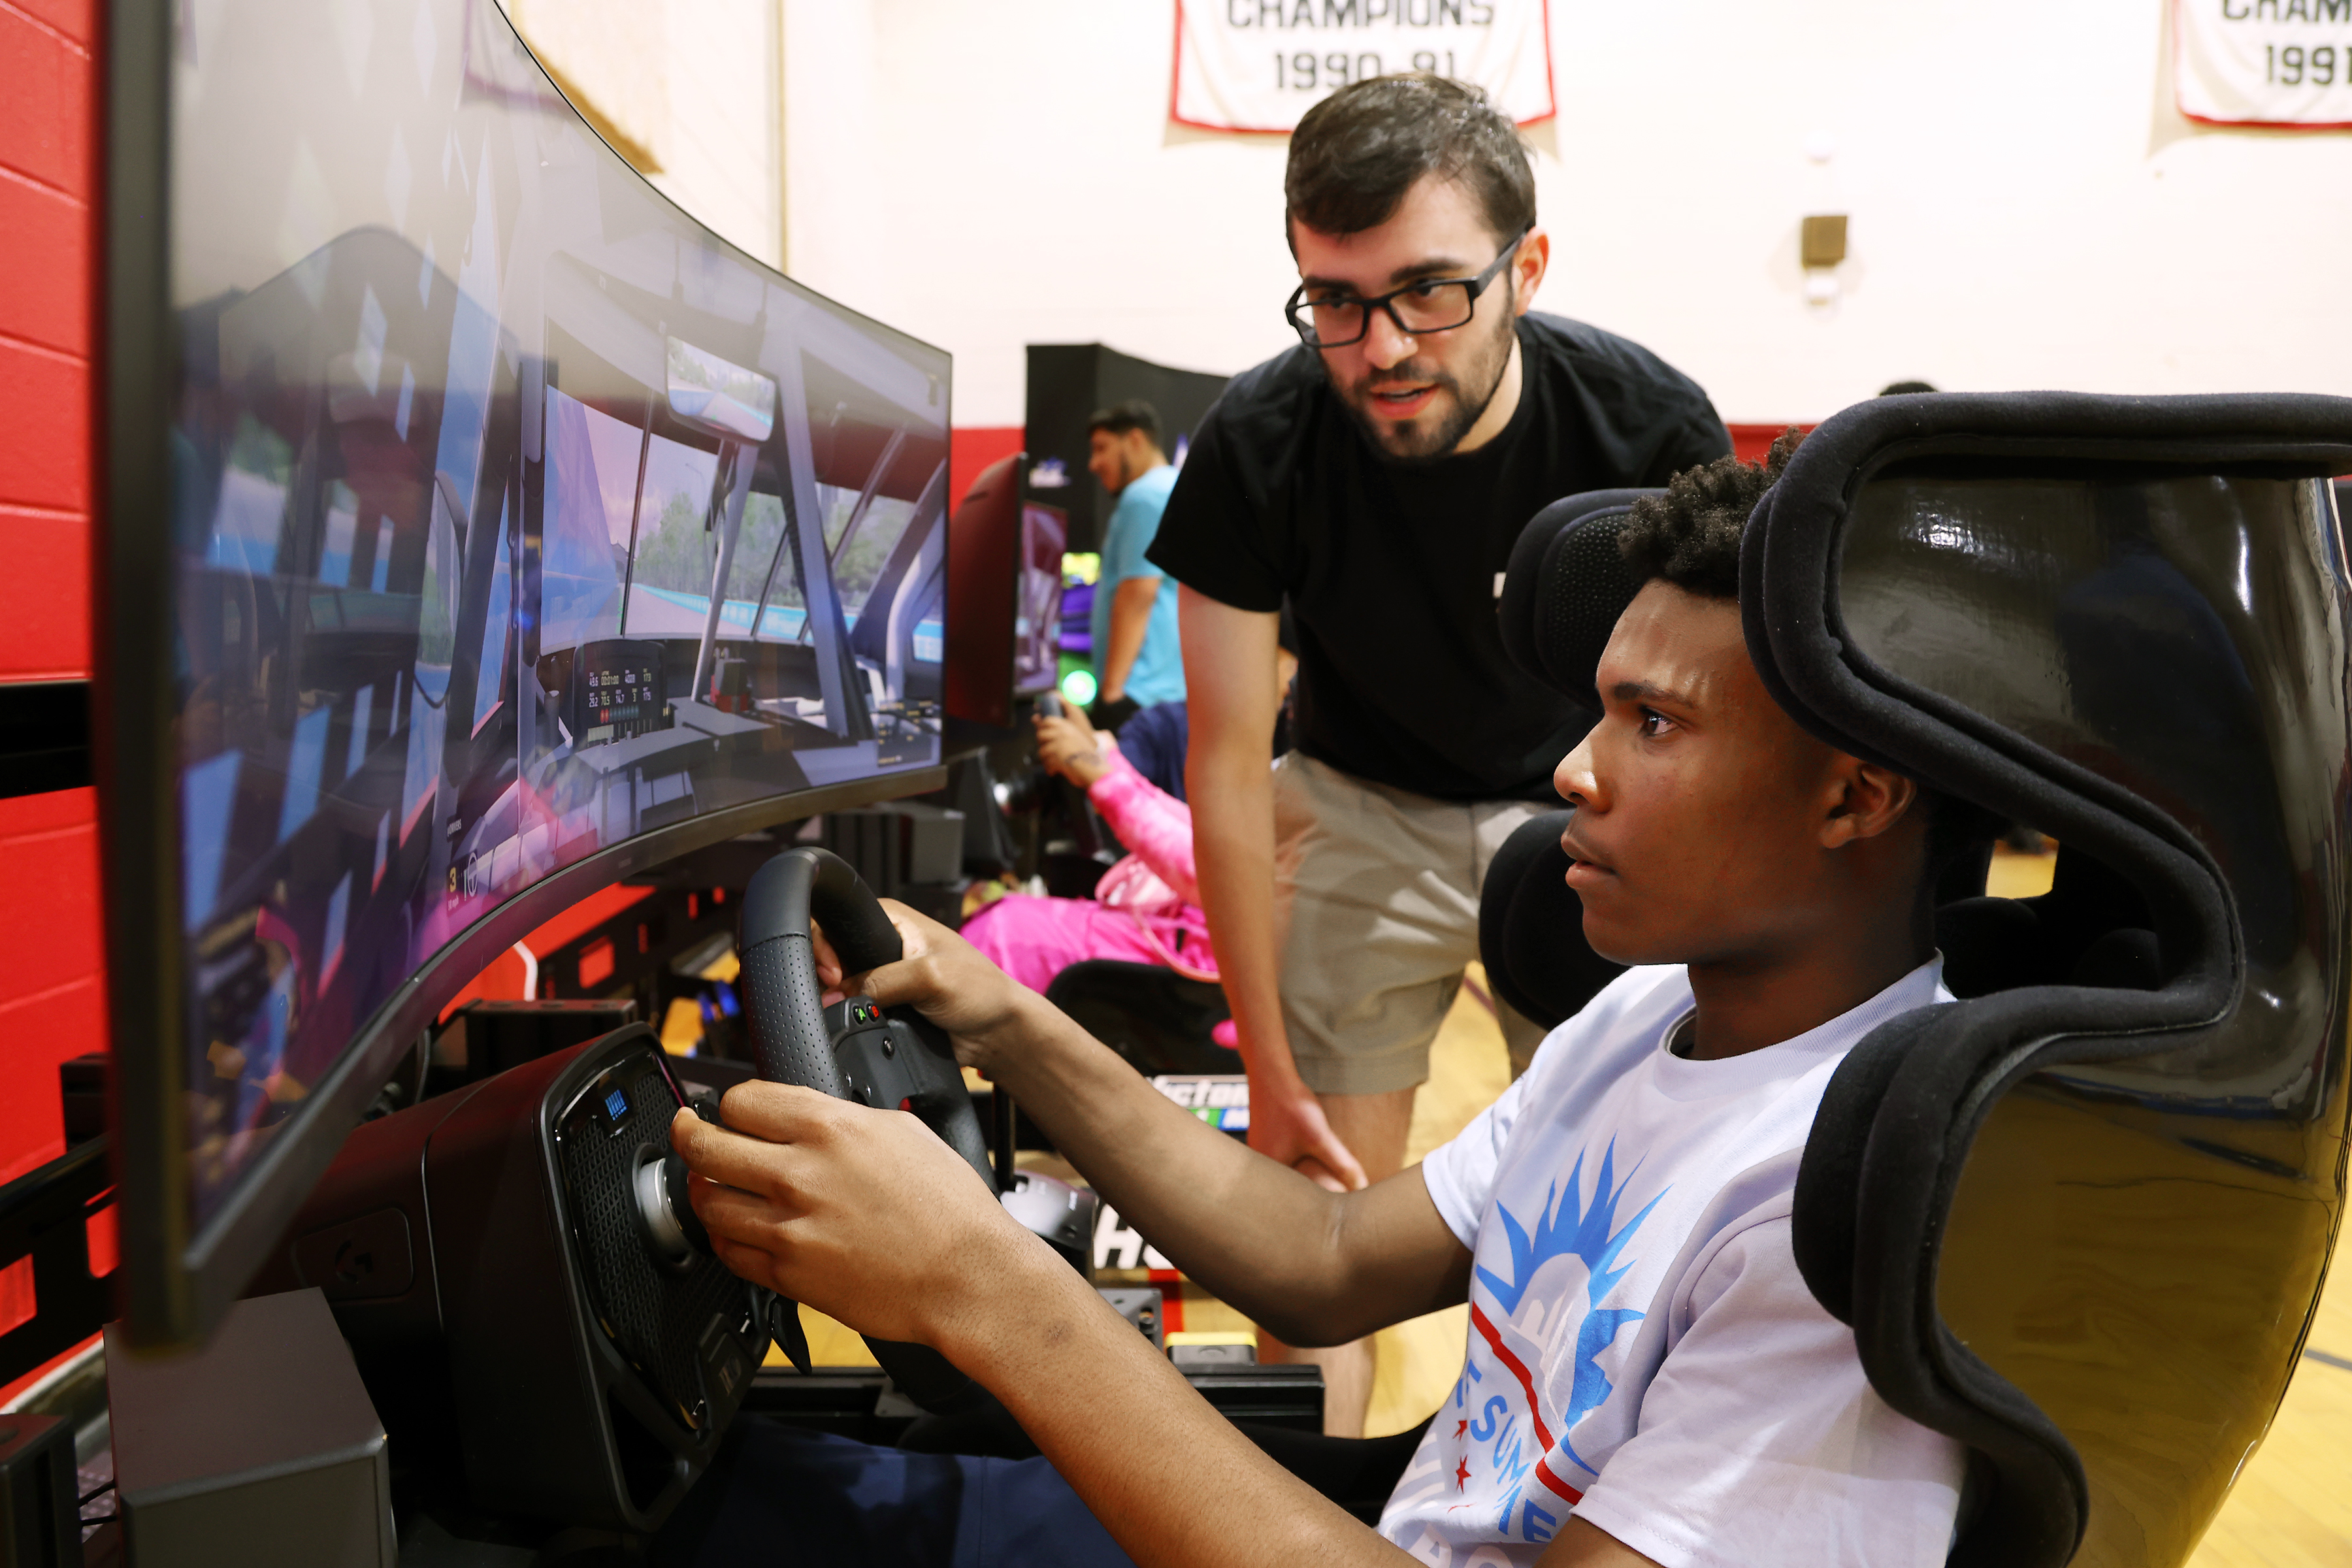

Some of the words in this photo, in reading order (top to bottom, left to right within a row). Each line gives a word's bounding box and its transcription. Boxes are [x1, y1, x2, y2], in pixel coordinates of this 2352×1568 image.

[1227, 0, 1494, 28] CHAMPIONS
[1276, 50, 1455, 89] 199091
[449, 866, 456, 893] 3
[859, 1008, 866, 1021] A
[872, 1005, 879, 1017] B
